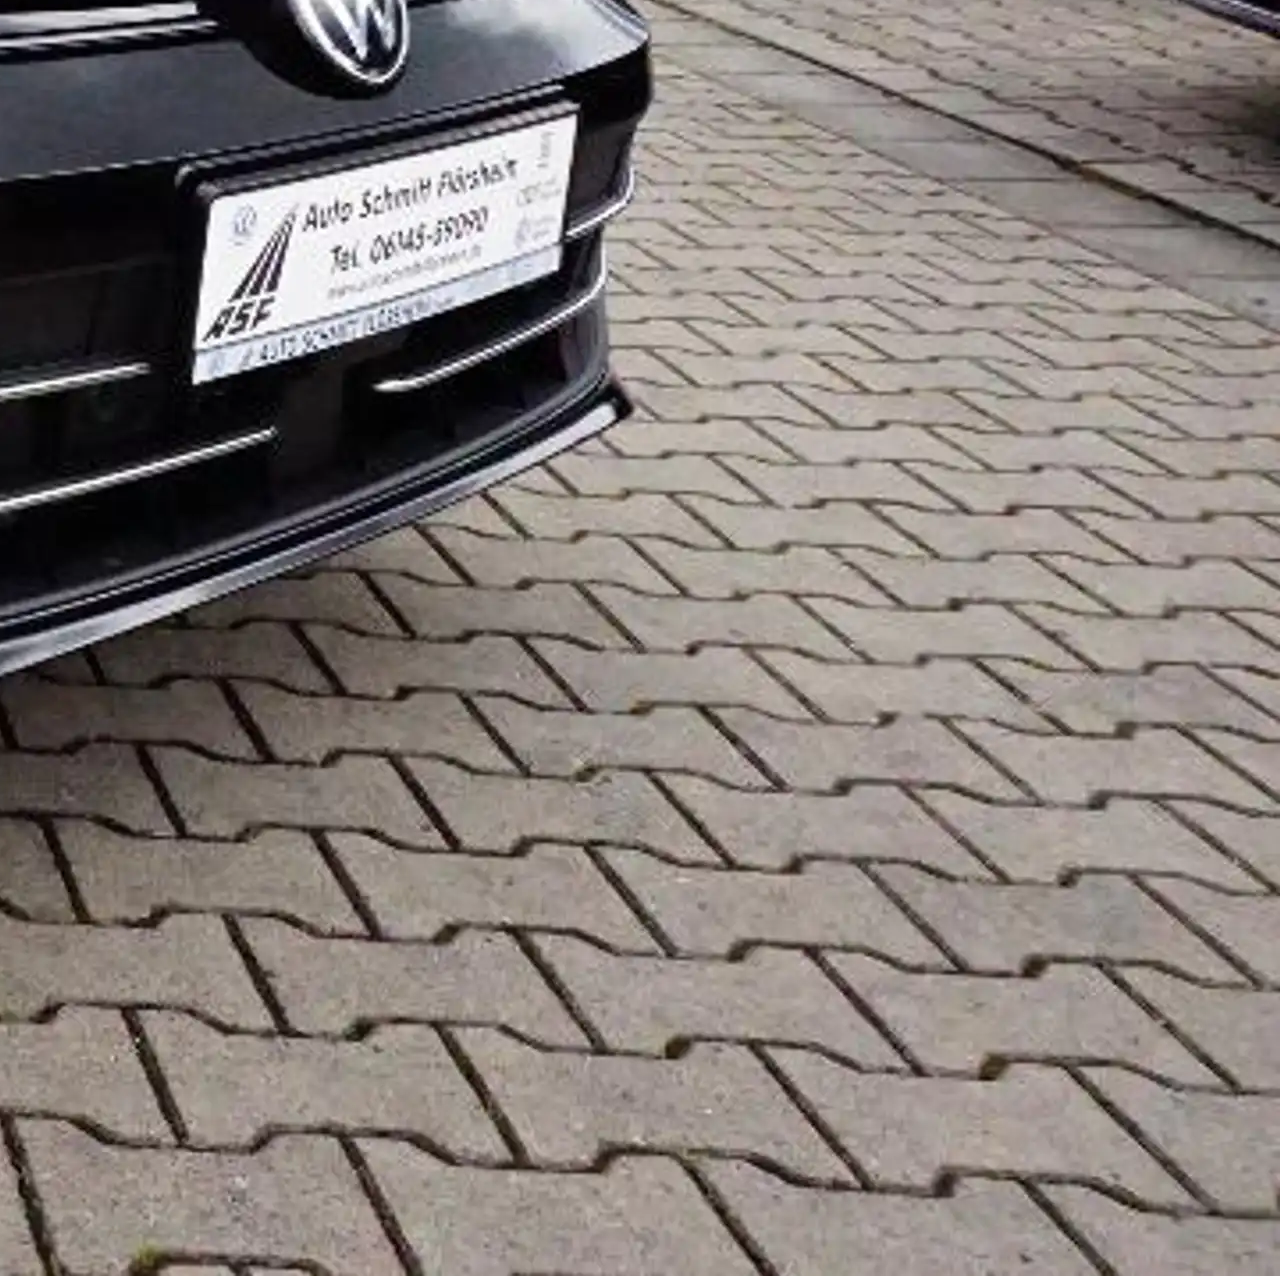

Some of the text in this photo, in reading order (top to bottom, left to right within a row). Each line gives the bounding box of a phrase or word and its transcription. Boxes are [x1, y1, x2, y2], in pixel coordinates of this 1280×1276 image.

[302, 198, 353, 232] Auto
[359, 176, 432, 219] Schmitt
[202, 295, 276, 342] ASF
